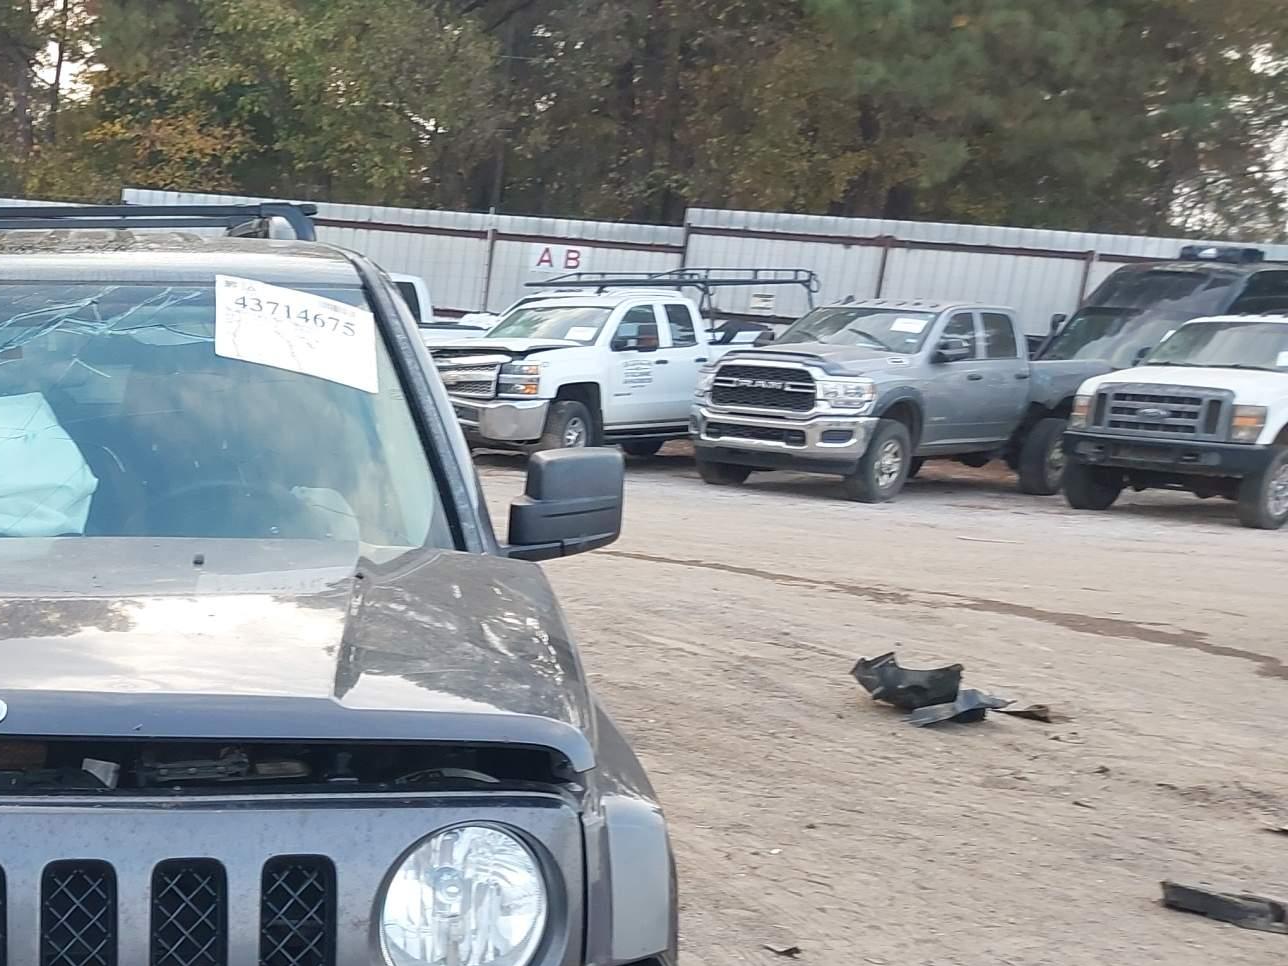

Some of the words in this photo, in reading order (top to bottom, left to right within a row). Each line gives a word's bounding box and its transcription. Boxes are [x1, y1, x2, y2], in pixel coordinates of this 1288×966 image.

[536, 247, 553, 267] A
[564, 249, 581, 269] B
[234, 295, 356, 337] 43714675
[735, 378, 783, 390] RAM
